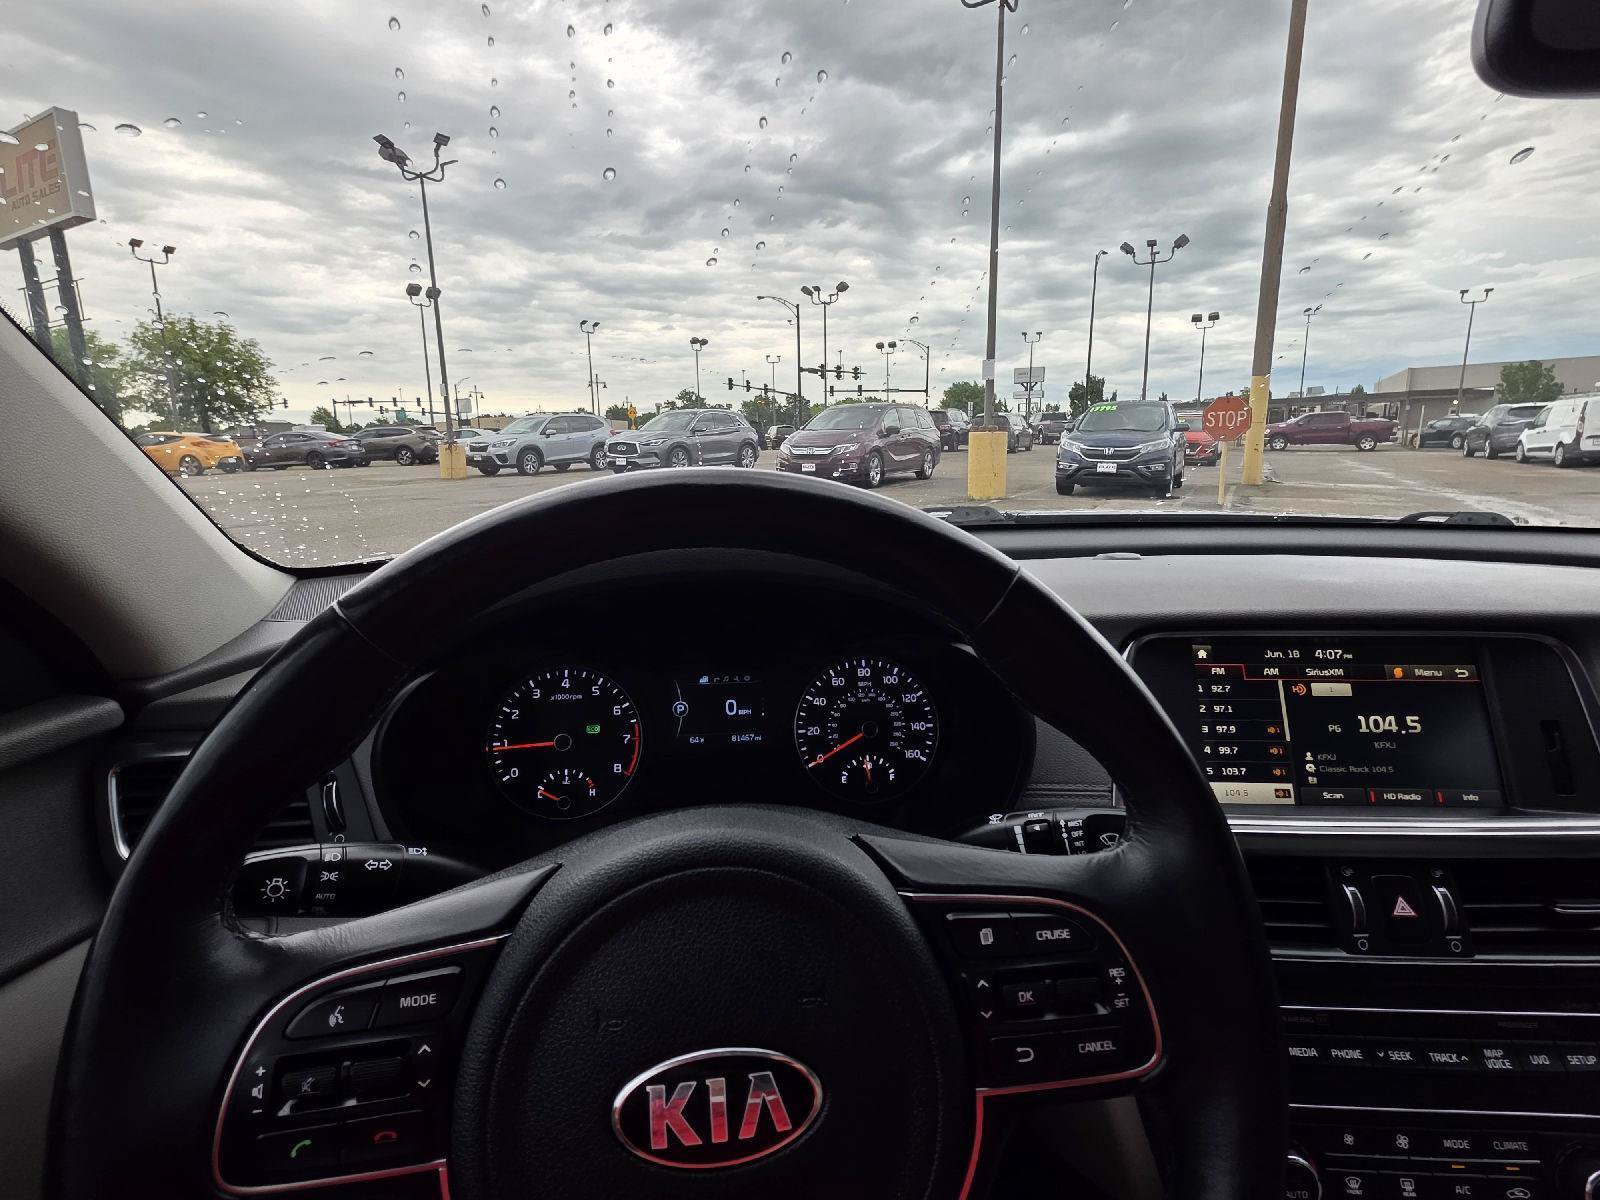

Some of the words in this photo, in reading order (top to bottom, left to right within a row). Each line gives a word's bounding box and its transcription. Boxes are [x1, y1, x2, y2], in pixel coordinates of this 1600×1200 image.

[11, 194, 31, 211] AUTO
[32, 182, 61, 203] SALES
[1205, 411, 1247, 427] STOP
[1288, 650, 1300, 658] 18
[1315, 649, 1343, 660] 4:07
[857, 668, 871, 677] 80
[1263, 668, 1279, 676] AM
[1305, 668, 1344, 677] SiriusXM
[1414, 668, 1443, 677] Menu
[561, 679, 570, 688] 4
[831, 678, 845, 686] 60
[882, 676, 899, 684] 100
[532, 689, 541, 698] 3
[591, 686, 600, 695] 5
[1211, 685, 1231, 693] 92.7
[902, 694, 917, 703] 120
[613, 706, 621, 715] 6
[676, 704, 685, 713] P
[725, 699, 737, 716] 0
[1199, 705, 1207, 713] 2
[1213, 705, 1233, 713] 97.1
[511, 710, 519, 719] 2
[910, 722, 926, 731] 140
[1201, 725, 1209, 733] 3
[1216, 725, 1236, 733] 97.9
[1328, 724, 1342, 733] P6
[1357, 715, 1422, 734] 104.5
[807, 726, 820, 735] 20
[503, 739, 508, 748] 1
[622, 735, 631, 744] 7
[904, 750, 921, 759] 160
[1204, 746, 1211, 754] 4
[1218, 746, 1238, 755] 99.7
[816, 754, 824, 763] 0
[510, 768, 519, 778] 0
[613, 764, 622, 773] 8
[1206, 767, 1213, 775] 5
[1222, 767, 1246, 776] 103.7
[1319, 765, 1347, 773] Classic
[1349, 765, 1370, 773] Rock
[841, 776, 847, 784] E
[589, 788, 596, 797] H
[1323, 791, 1345, 800] Scan
[1383, 792, 1397, 800] HD
[1398, 792, 1422, 801] Radio
[1462, 793, 1479, 801] Info
[1067, 819, 1083, 827] MIST
[1070, 829, 1084, 837] OFF
[1036, 929, 1070, 940] CRUISE
[1109, 968, 1125, 977] RES
[400, 993, 436, 1008] MODE
[1018, 991, 1033, 1002] OK
[1114, 998, 1129, 1008] SET
[1078, 1041, 1116, 1053] CANCEL
[1289, 1047, 1318, 1057] MEDIA
[1331, 1049, 1363, 1059] PHONE
[1389, 1051, 1413, 1061] SEEK
[1483, 1049, 1503, 1058] MAP
[1428, 1052, 1460, 1063] TRACK
[1529, 1055, 1550, 1065] UVO
[1566, 1055, 1597, 1065] SETUP
[1484, 1059, 1513, 1069] VOICE
[646, 1071, 792, 1149] KIA
[1443, 1139, 1470, 1149] MODE
[1493, 1141, 1529, 1151] CLIMATE
[1286, 1190, 1309, 1199] AUTO
[1456, 1185, 1471, 1195] A/C
